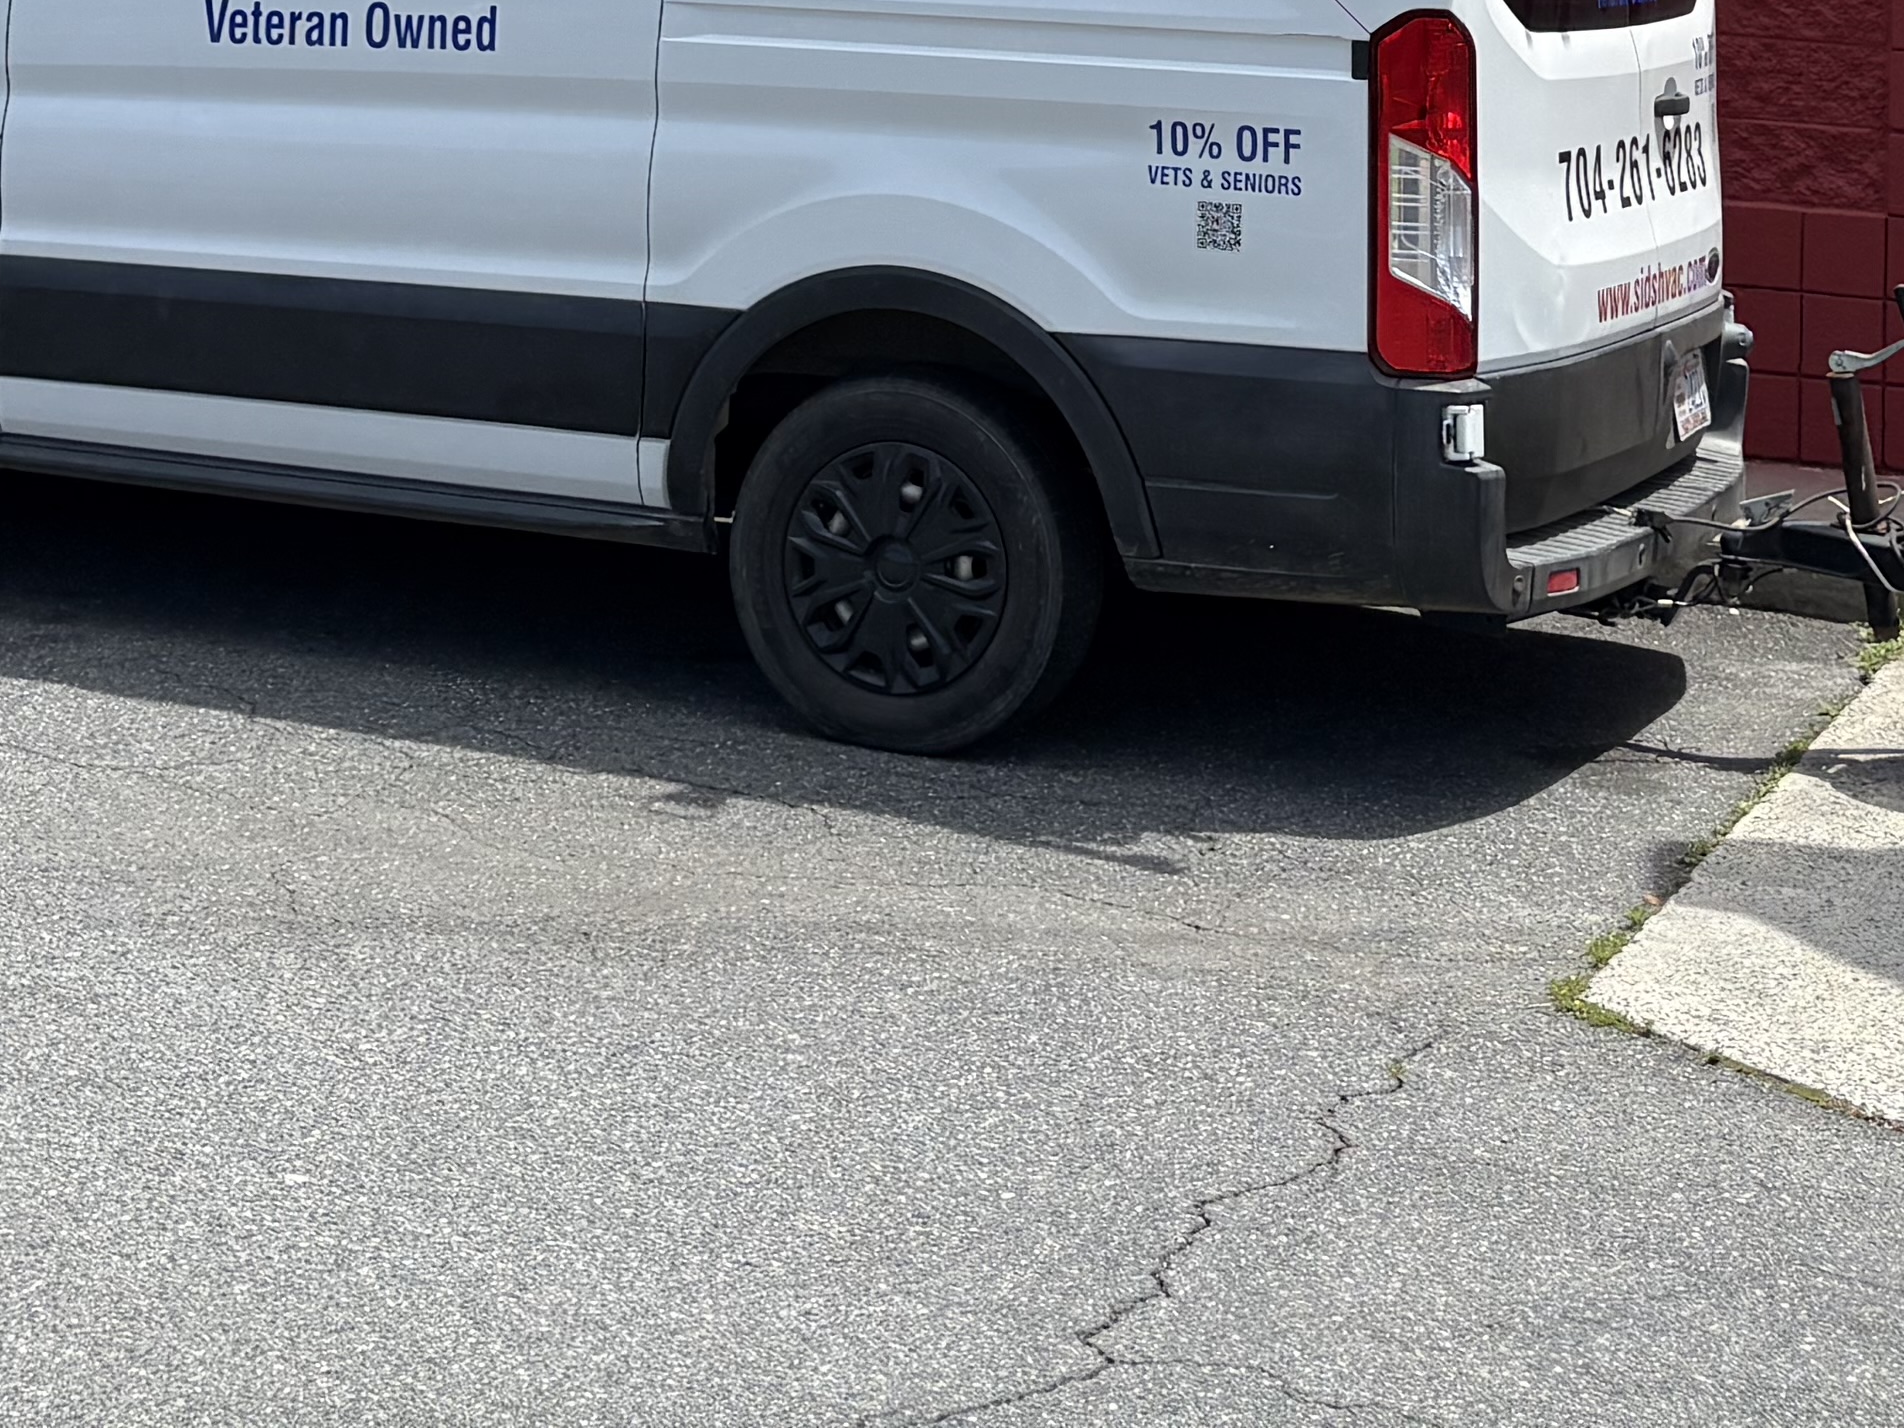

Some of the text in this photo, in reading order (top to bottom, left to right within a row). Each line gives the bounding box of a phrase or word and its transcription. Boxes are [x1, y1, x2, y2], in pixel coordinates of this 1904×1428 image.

[365, 1, 497, 52] Owned
[1149, 119, 1302, 165] 10% OFF
[1147, 164, 1302, 196] VETS & SENIORS
[1558, 121, 1707, 222] 704-261-6283
